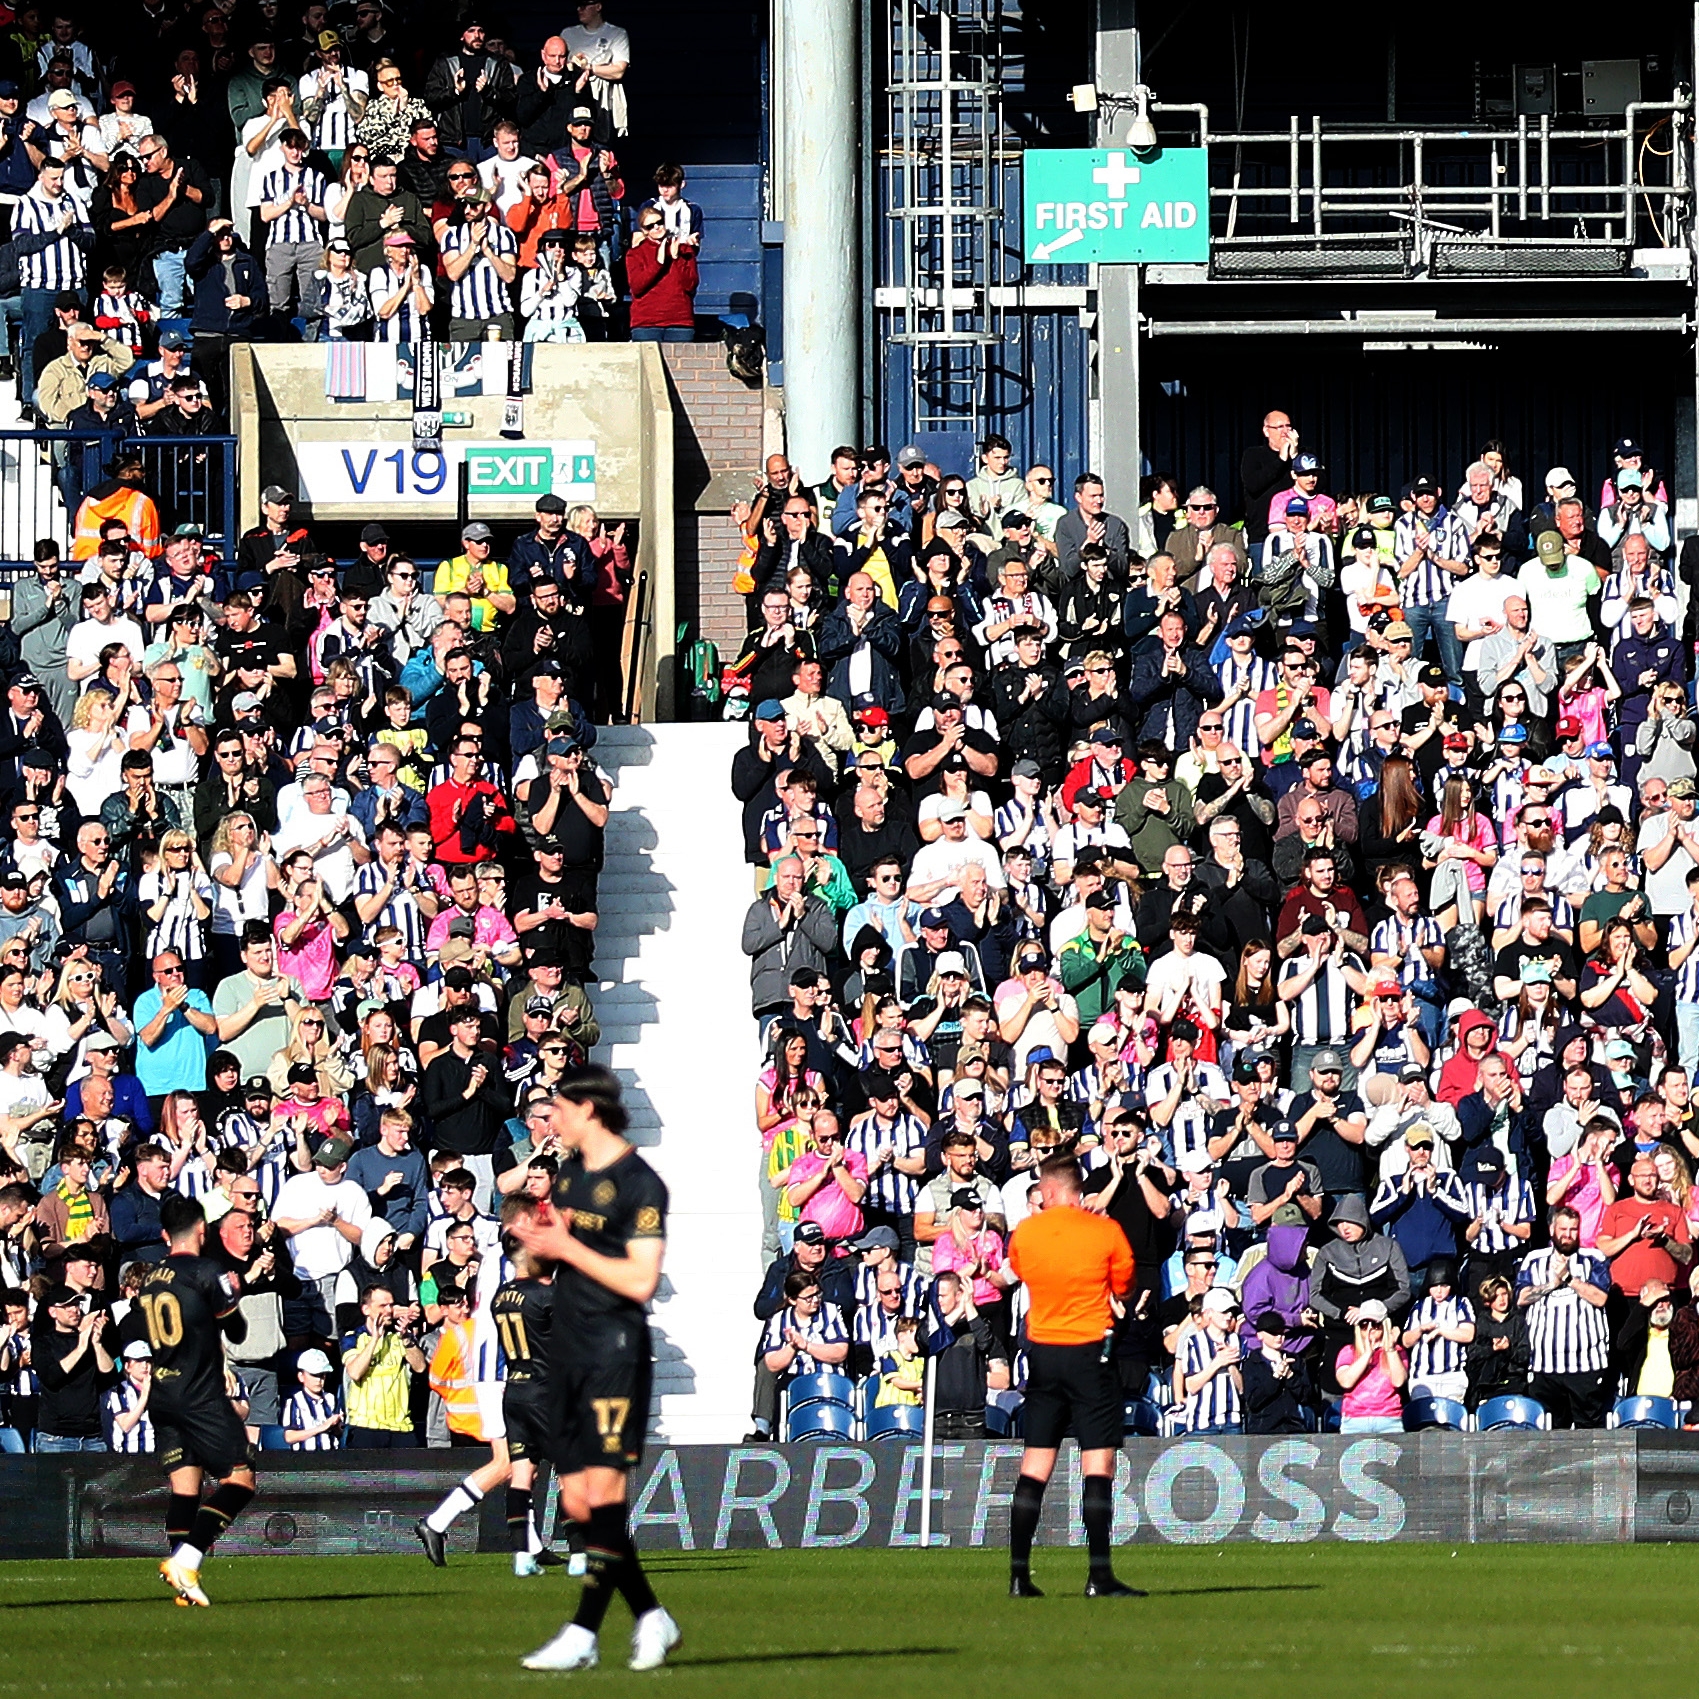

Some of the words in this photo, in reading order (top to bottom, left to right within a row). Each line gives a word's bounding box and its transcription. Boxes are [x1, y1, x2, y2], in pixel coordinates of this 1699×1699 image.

[1035, 202, 1129, 230] FIRST
[1140, 201, 1198, 229] AID
[341, 448, 448, 496] V19
[470, 455, 547, 487] EXIT
[139, 1291, 184, 1350] 10
[495, 1312, 531, 1361] 11
[591, 1397, 631, 1436] 17
